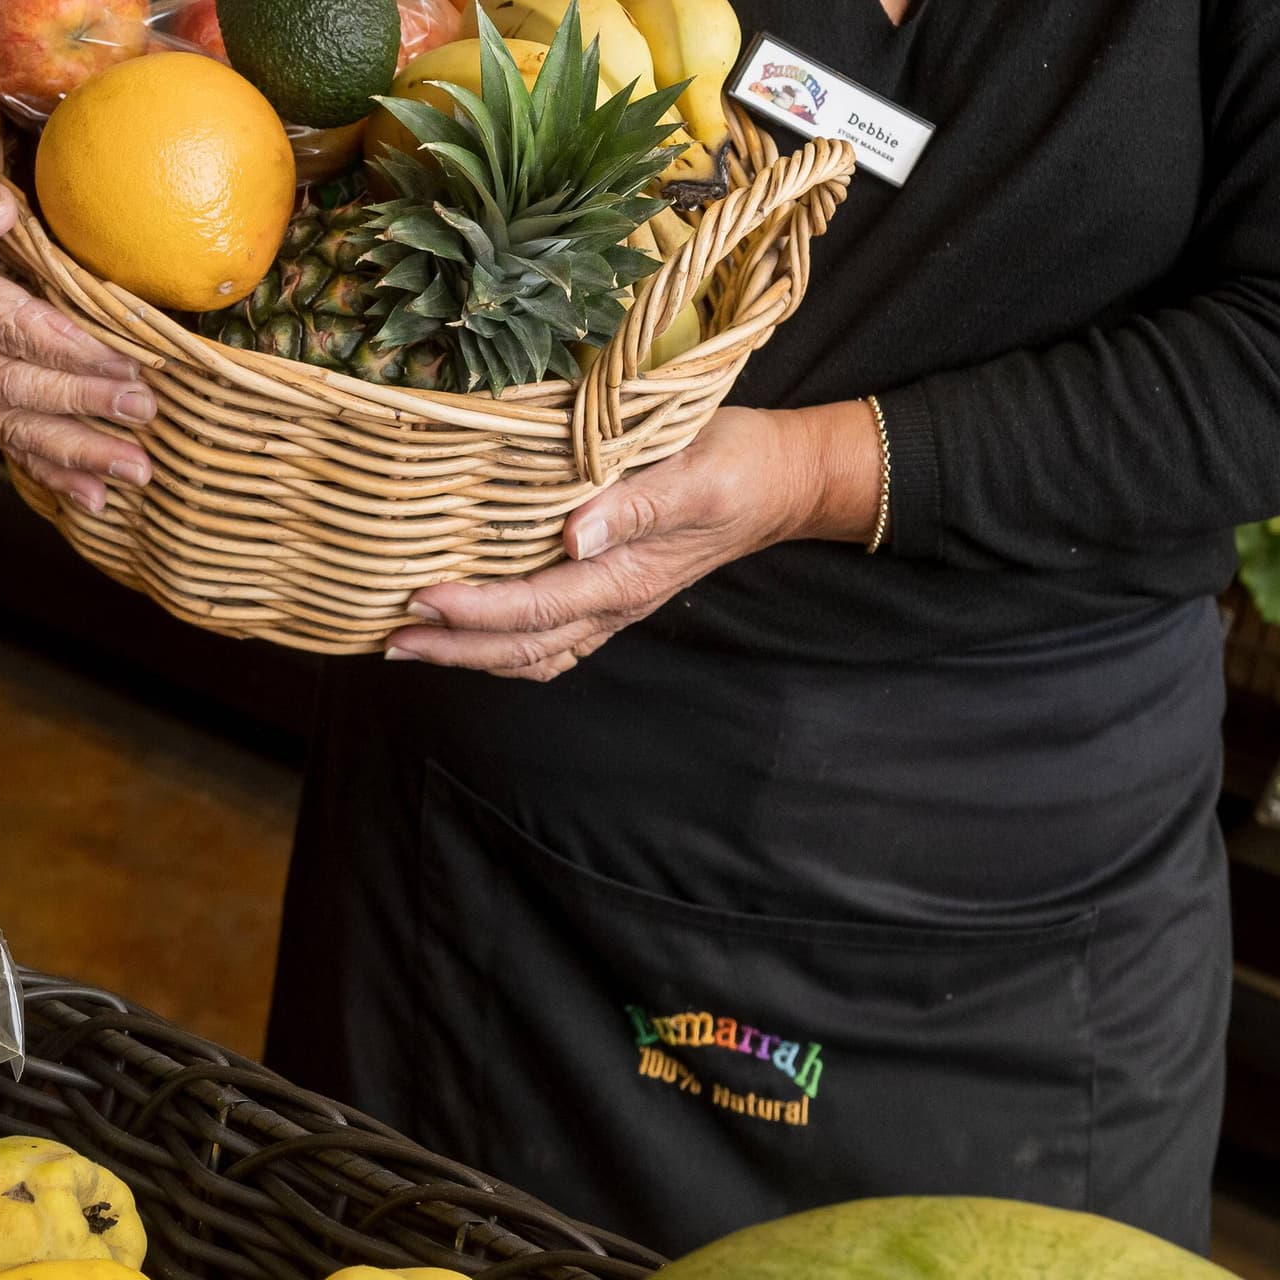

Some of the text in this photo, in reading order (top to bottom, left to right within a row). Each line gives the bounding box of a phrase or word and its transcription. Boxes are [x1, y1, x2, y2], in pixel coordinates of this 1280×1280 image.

[837, 128, 895, 163] STORE MANAGER
[848, 112, 899, 149] Debbie
[638, 1046, 810, 1127] 100% Natural
